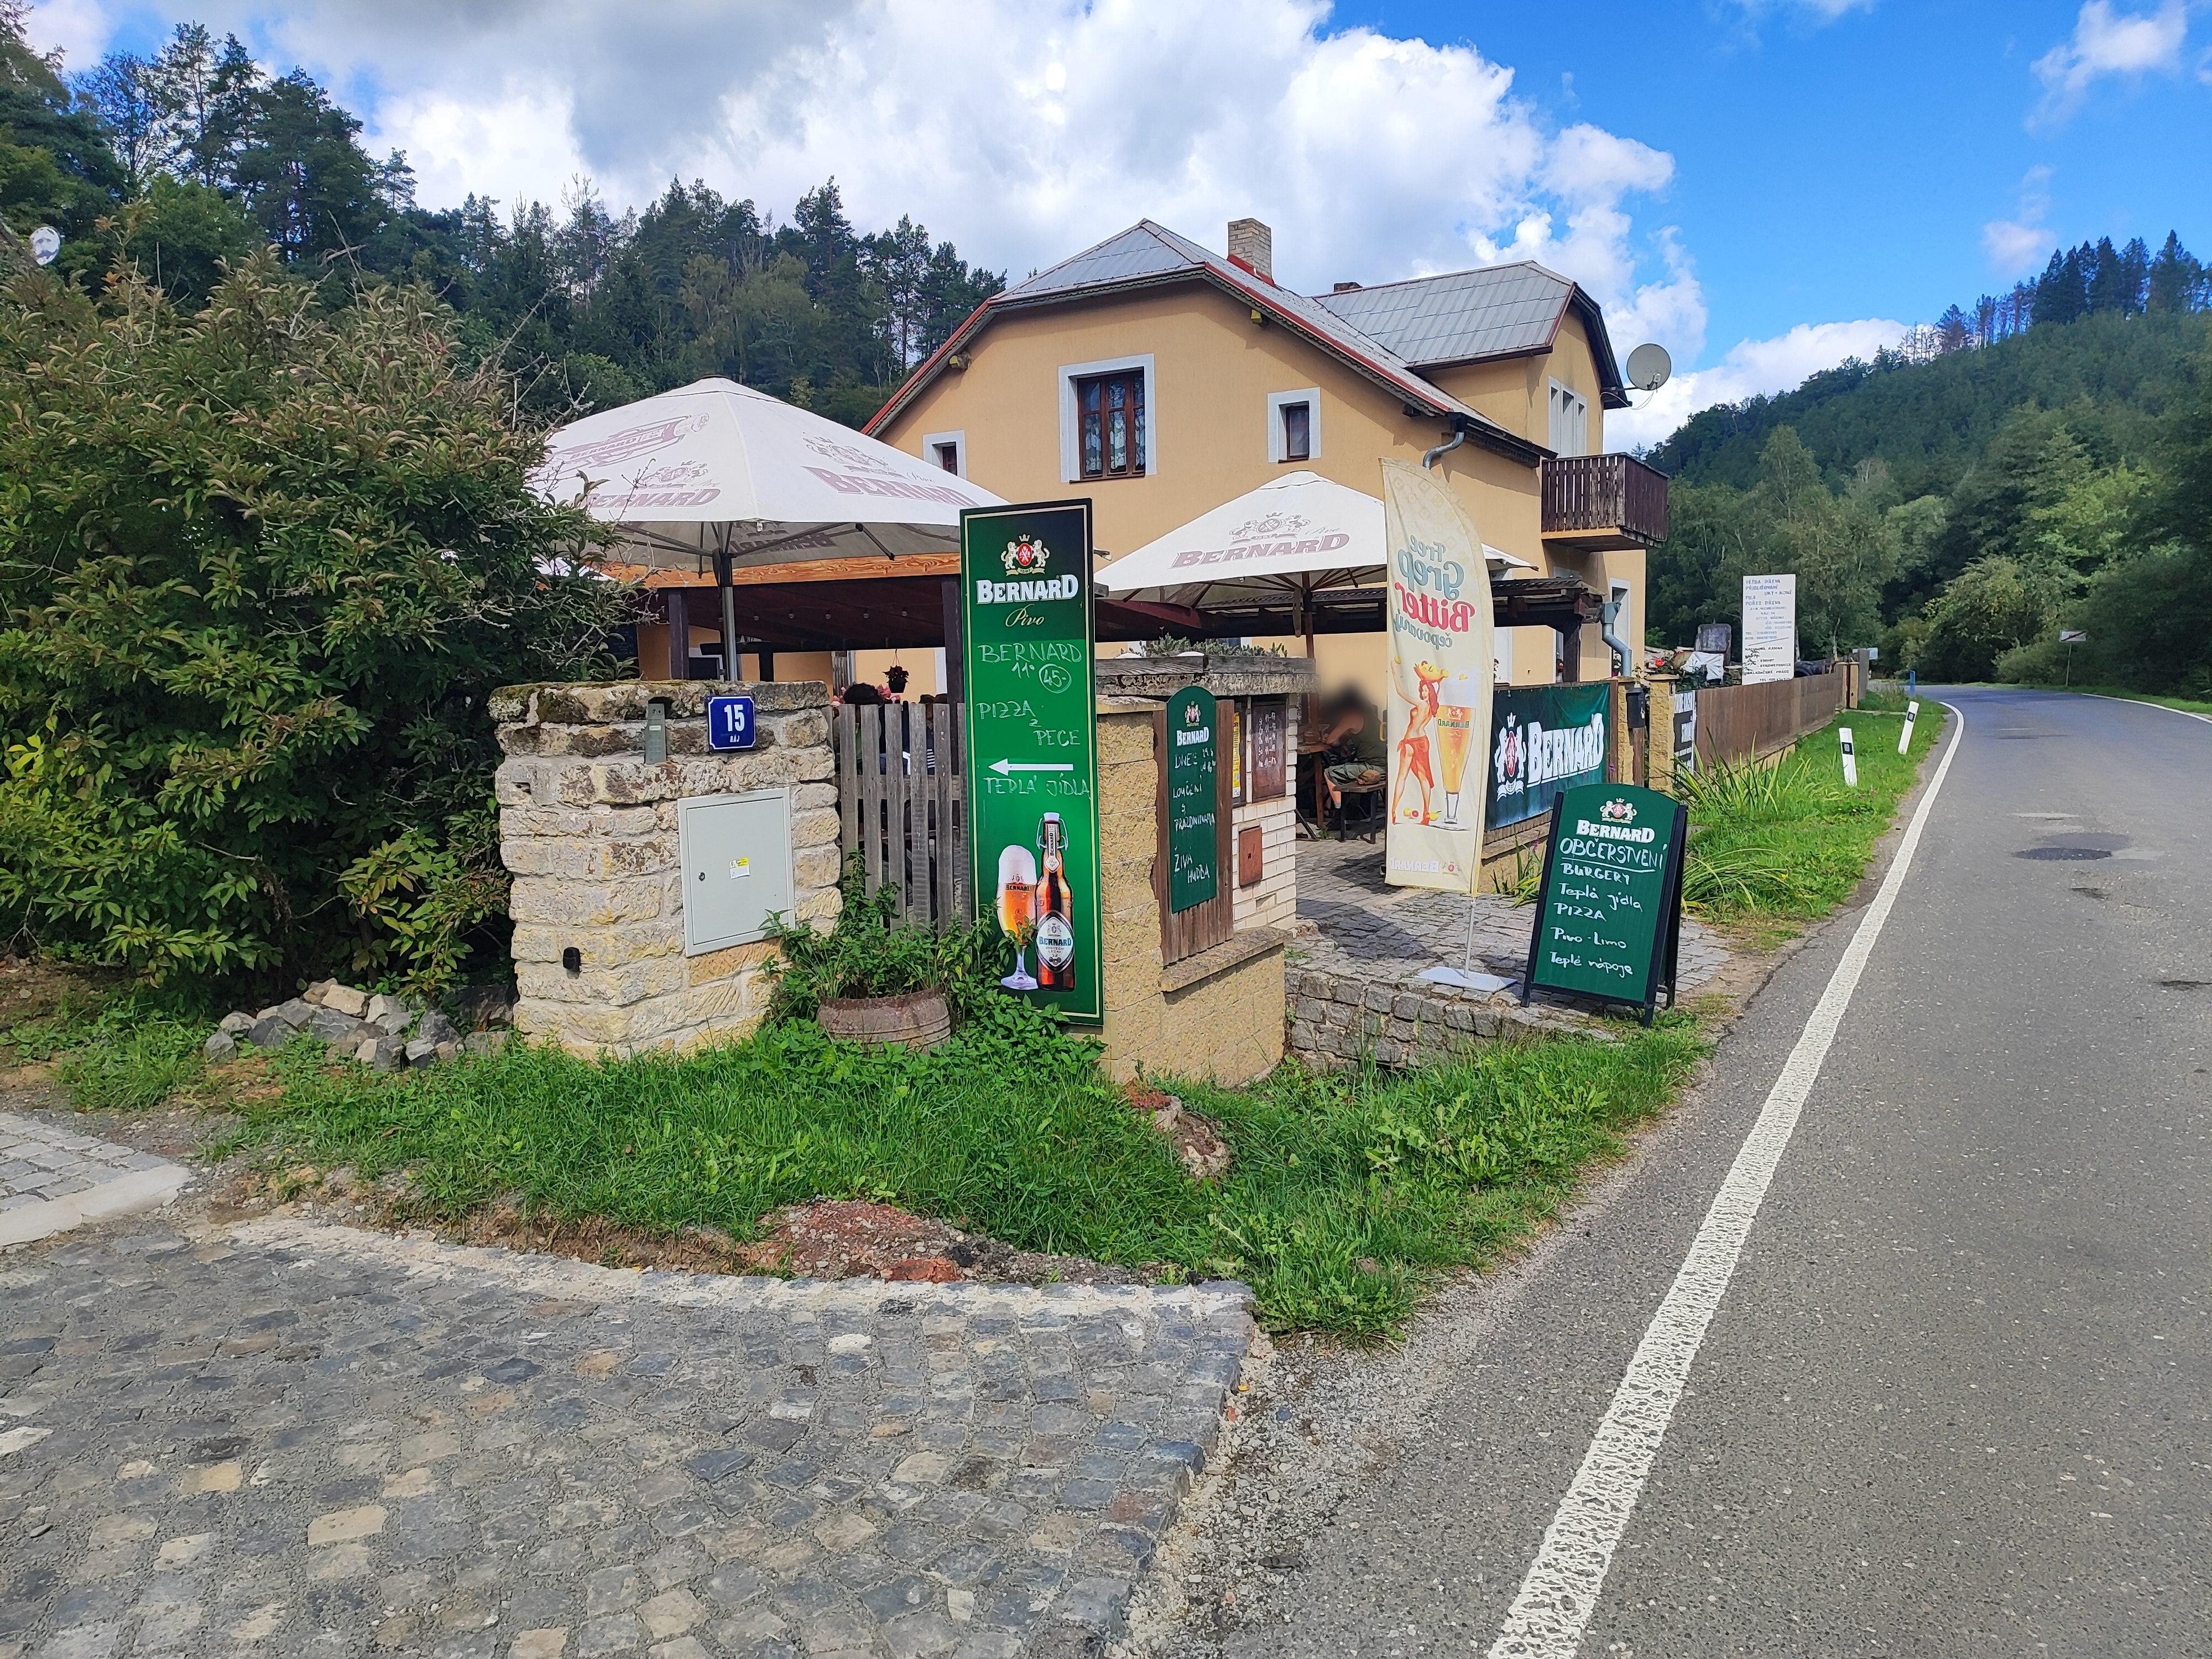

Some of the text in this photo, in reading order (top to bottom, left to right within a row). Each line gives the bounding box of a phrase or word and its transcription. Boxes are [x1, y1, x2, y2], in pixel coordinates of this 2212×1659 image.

[801, 466, 980, 508] BERNARD
[1168, 533, 1350, 569] BERNARD
[976, 574, 1079, 604] BERNARD
[1005, 603, 1045, 628] Pivo
[978, 643, 1082, 663] BERNARD
[724, 704, 745, 732] 15
[976, 700, 1036, 719] PIZZA
[1033, 729, 1081, 746] PECE
[1176, 726, 1209, 747] BERNARD
[1527, 713, 1604, 788] BERNARD
[1046, 772, 1091, 800] JÍDLA
[1575, 819, 1655, 843] BERNARD
[1559, 837, 1667, 870] OBČERSTVENÍ
[1187, 863, 1210, 884] HUDBA
[1560, 863, 1630, 885] BURGERY
[1553, 902, 1607, 922] PIZZA
[1039, 936, 1072, 946] BERNARD
[1550, 951, 1634, 978] Teplé nápoje
